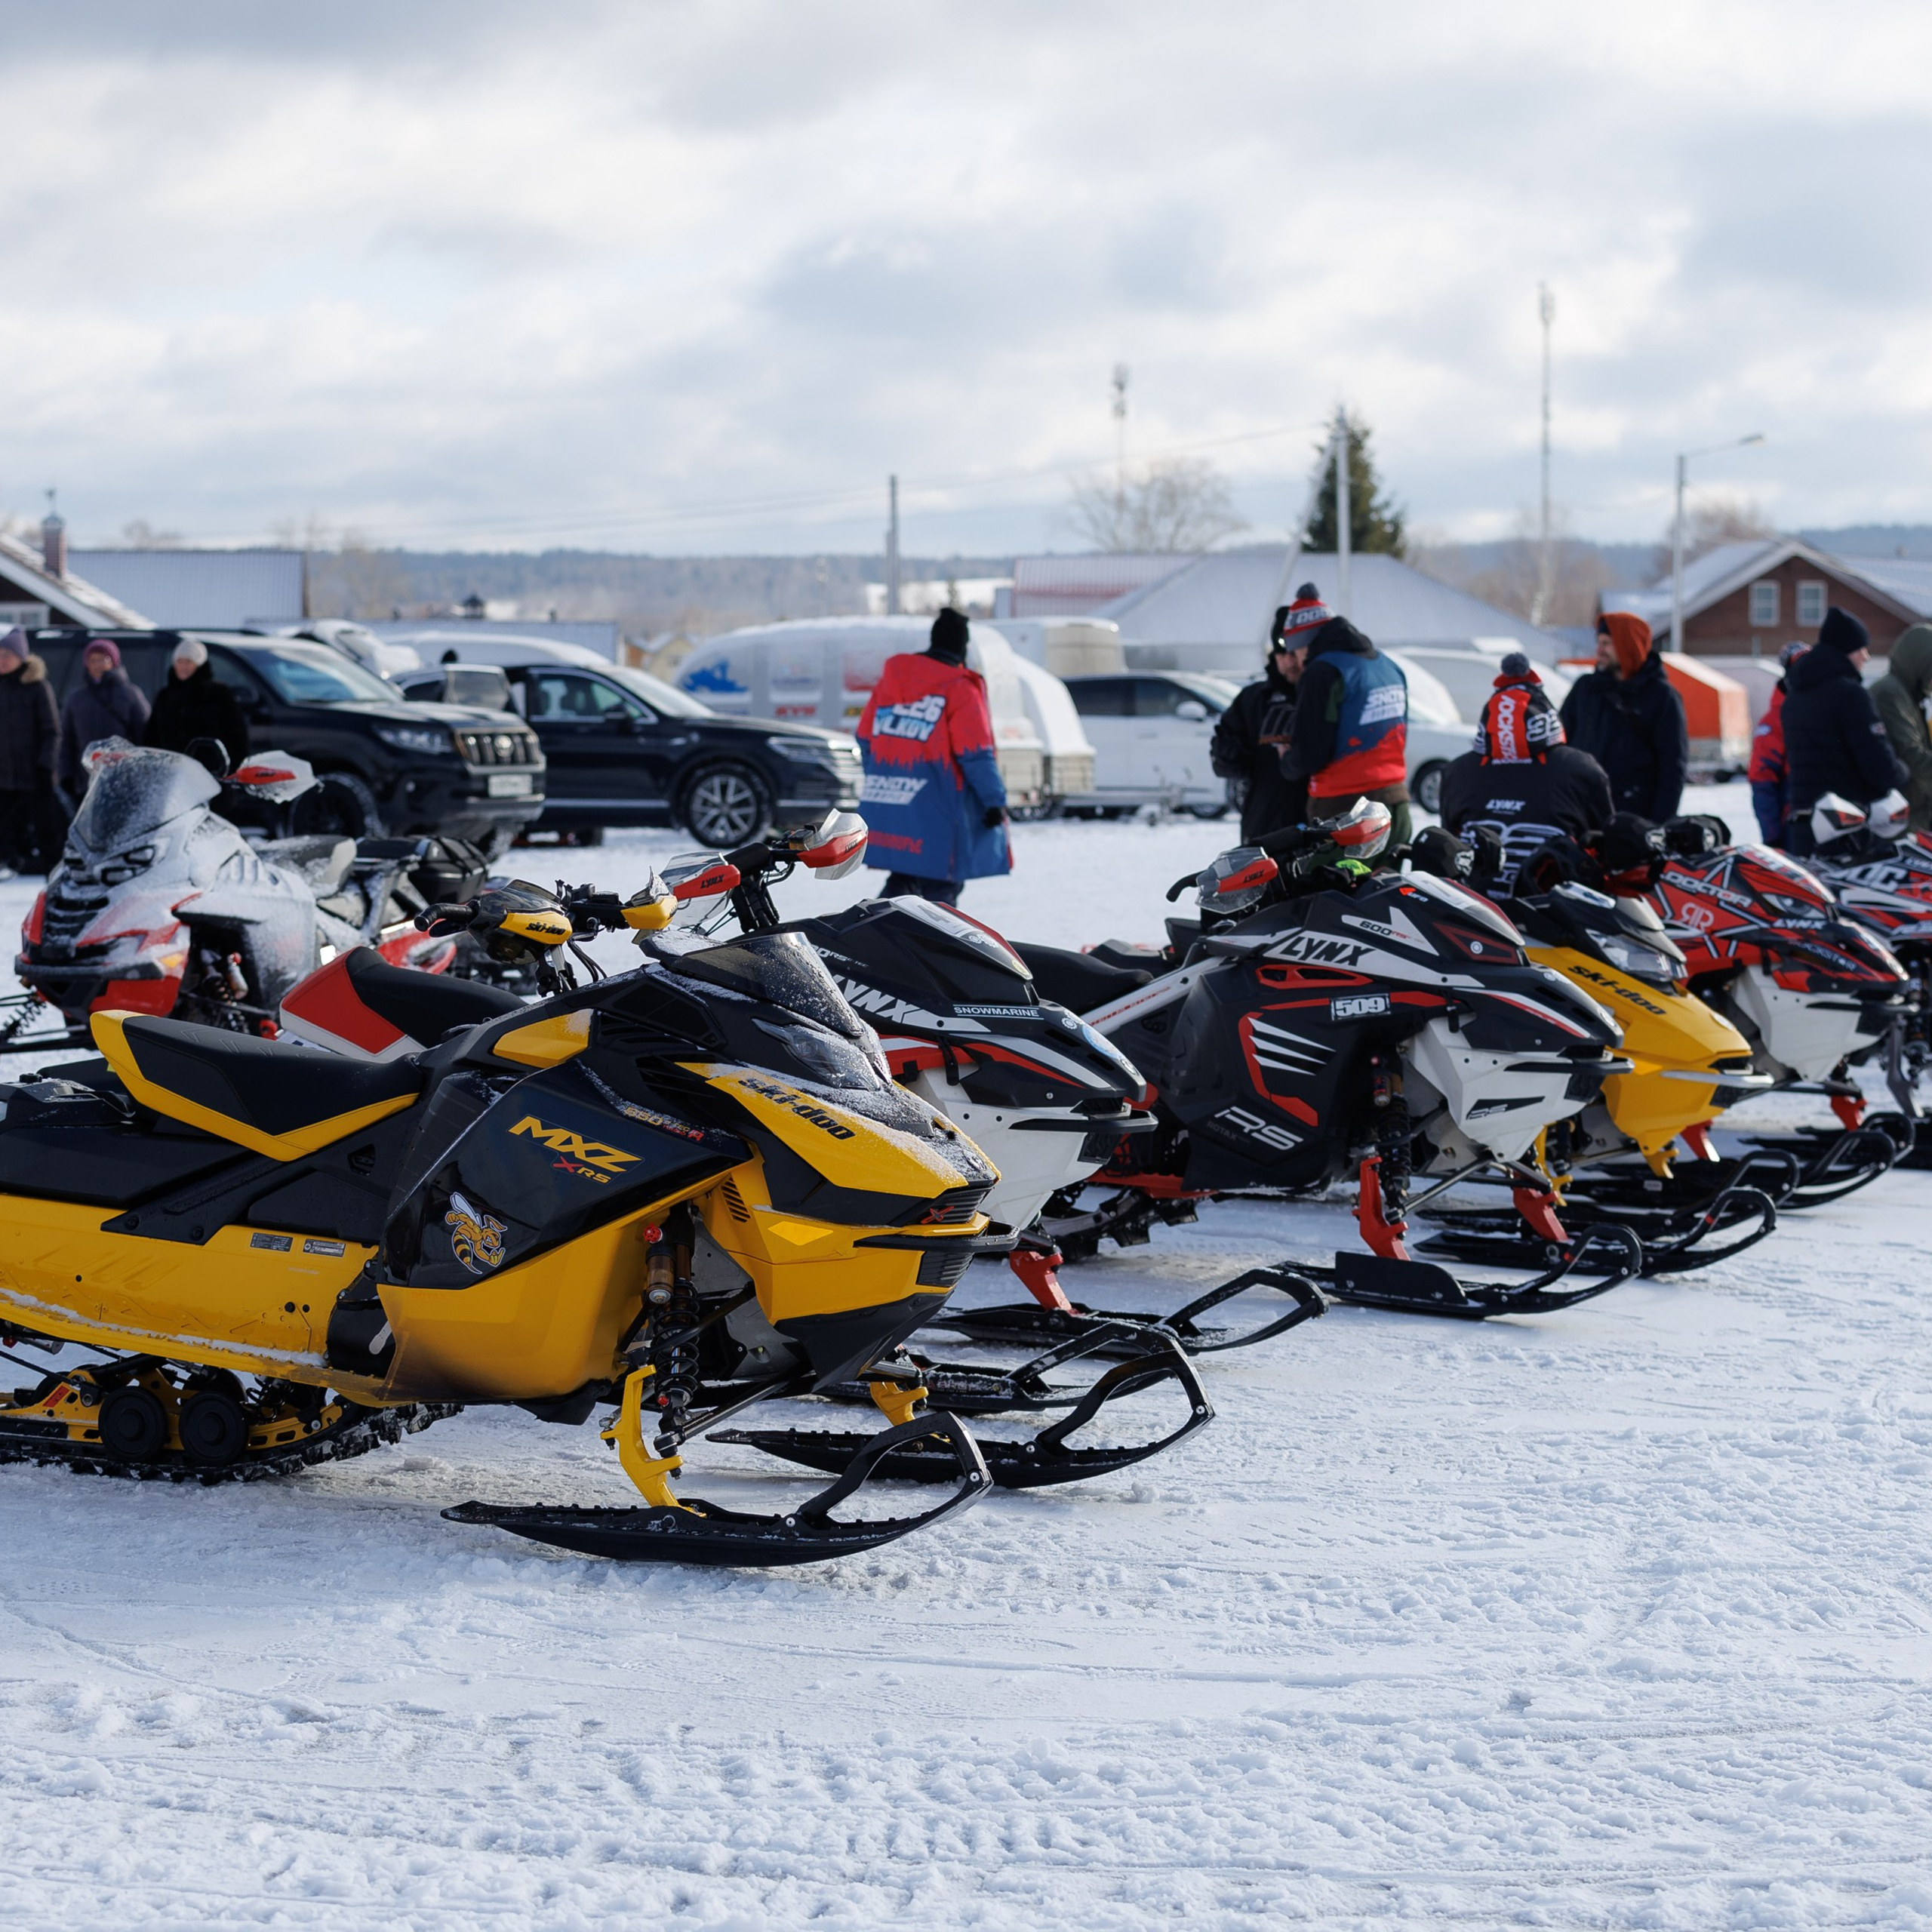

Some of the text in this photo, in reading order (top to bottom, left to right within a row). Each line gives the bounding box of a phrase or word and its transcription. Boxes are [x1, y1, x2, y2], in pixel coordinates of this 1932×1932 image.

[1485, 799, 1526, 811] LYNX
[700, 874, 725, 888] LYNX
[1242, 870, 1265, 883] LYNX
[525, 921, 566, 937] ski-doo
[1359, 920, 1392, 937] 600
[1774, 918, 1828, 930] LYNX
[1279, 937, 1377, 967] LYNX
[1567, 965, 1666, 1014] ski-doo
[954, 1007, 1040, 1017] SNOWMARINE
[1335, 996, 1386, 1017] 509
[738, 1078, 856, 1140] ski-doo
[1207, 1120, 1238, 1140] ROTAX
[1214, 1106, 1304, 1150] RS
[508, 1115, 642, 1172] MXZ
